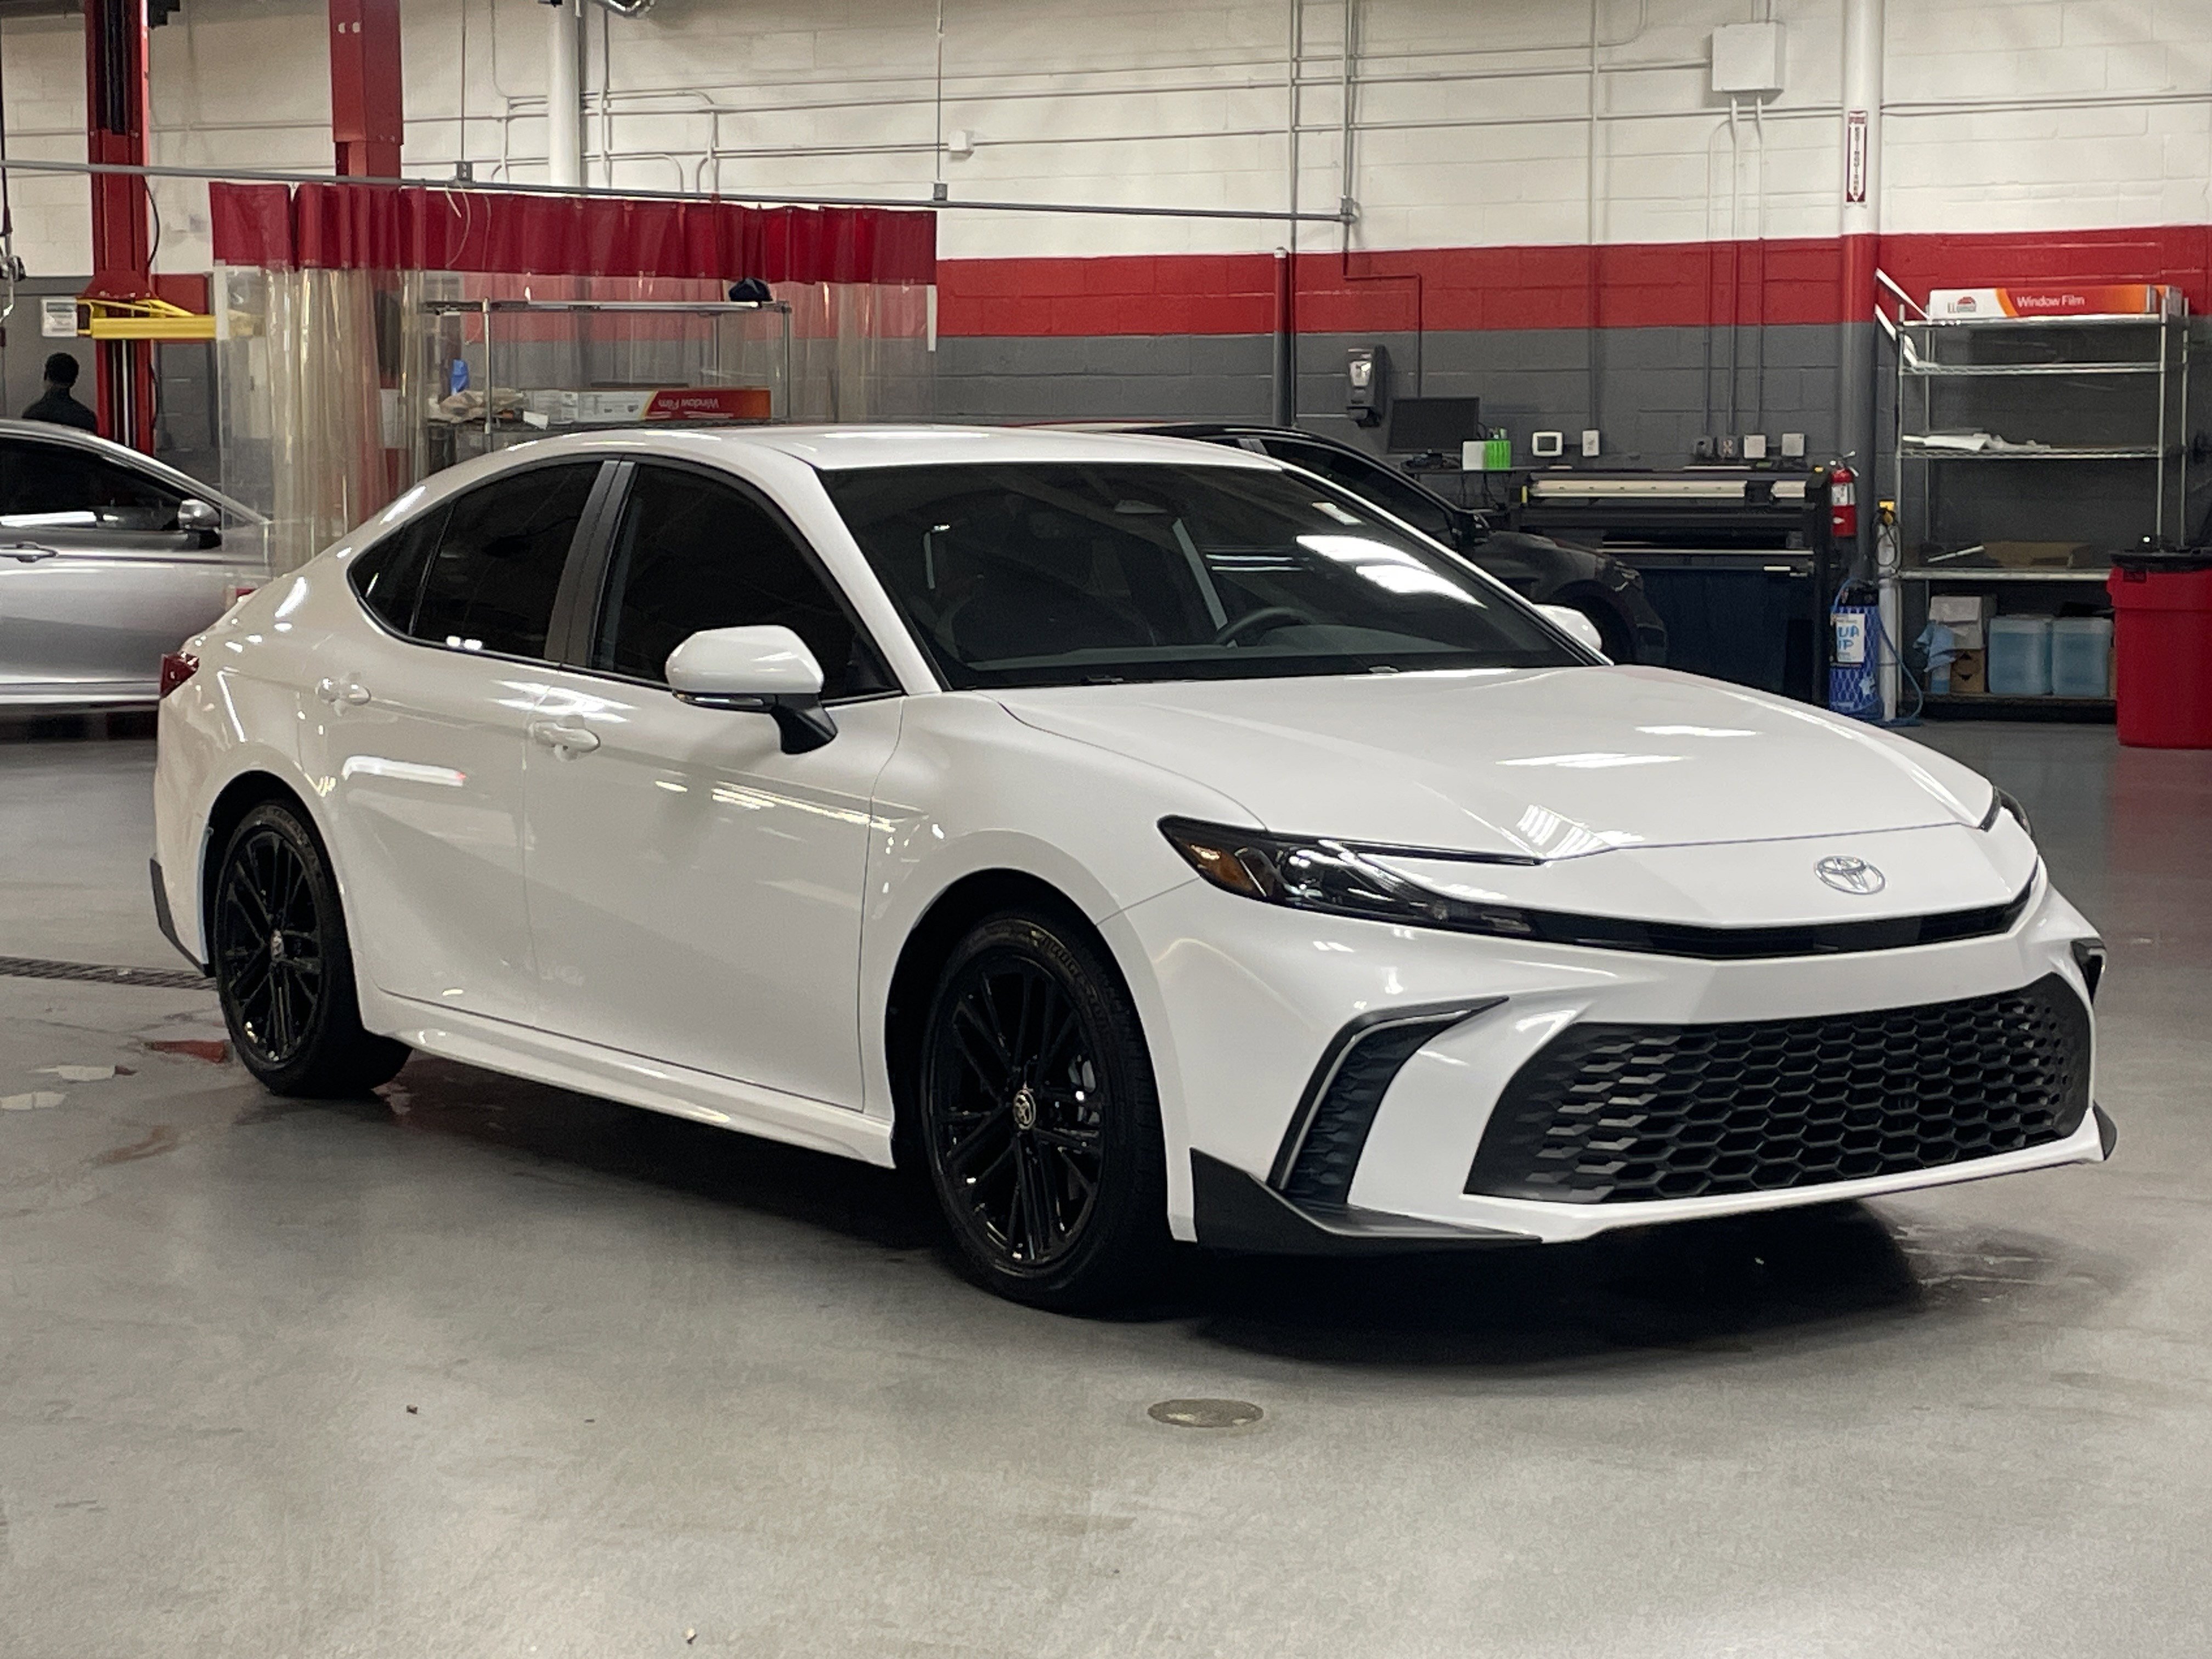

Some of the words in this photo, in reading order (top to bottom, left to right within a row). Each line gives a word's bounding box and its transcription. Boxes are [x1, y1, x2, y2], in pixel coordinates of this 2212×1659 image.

[2016, 295, 2060, 307] Window
[2061, 294, 2085, 306] Film
[658, 398, 679, 410] Film
[681, 398, 720, 409] Window
